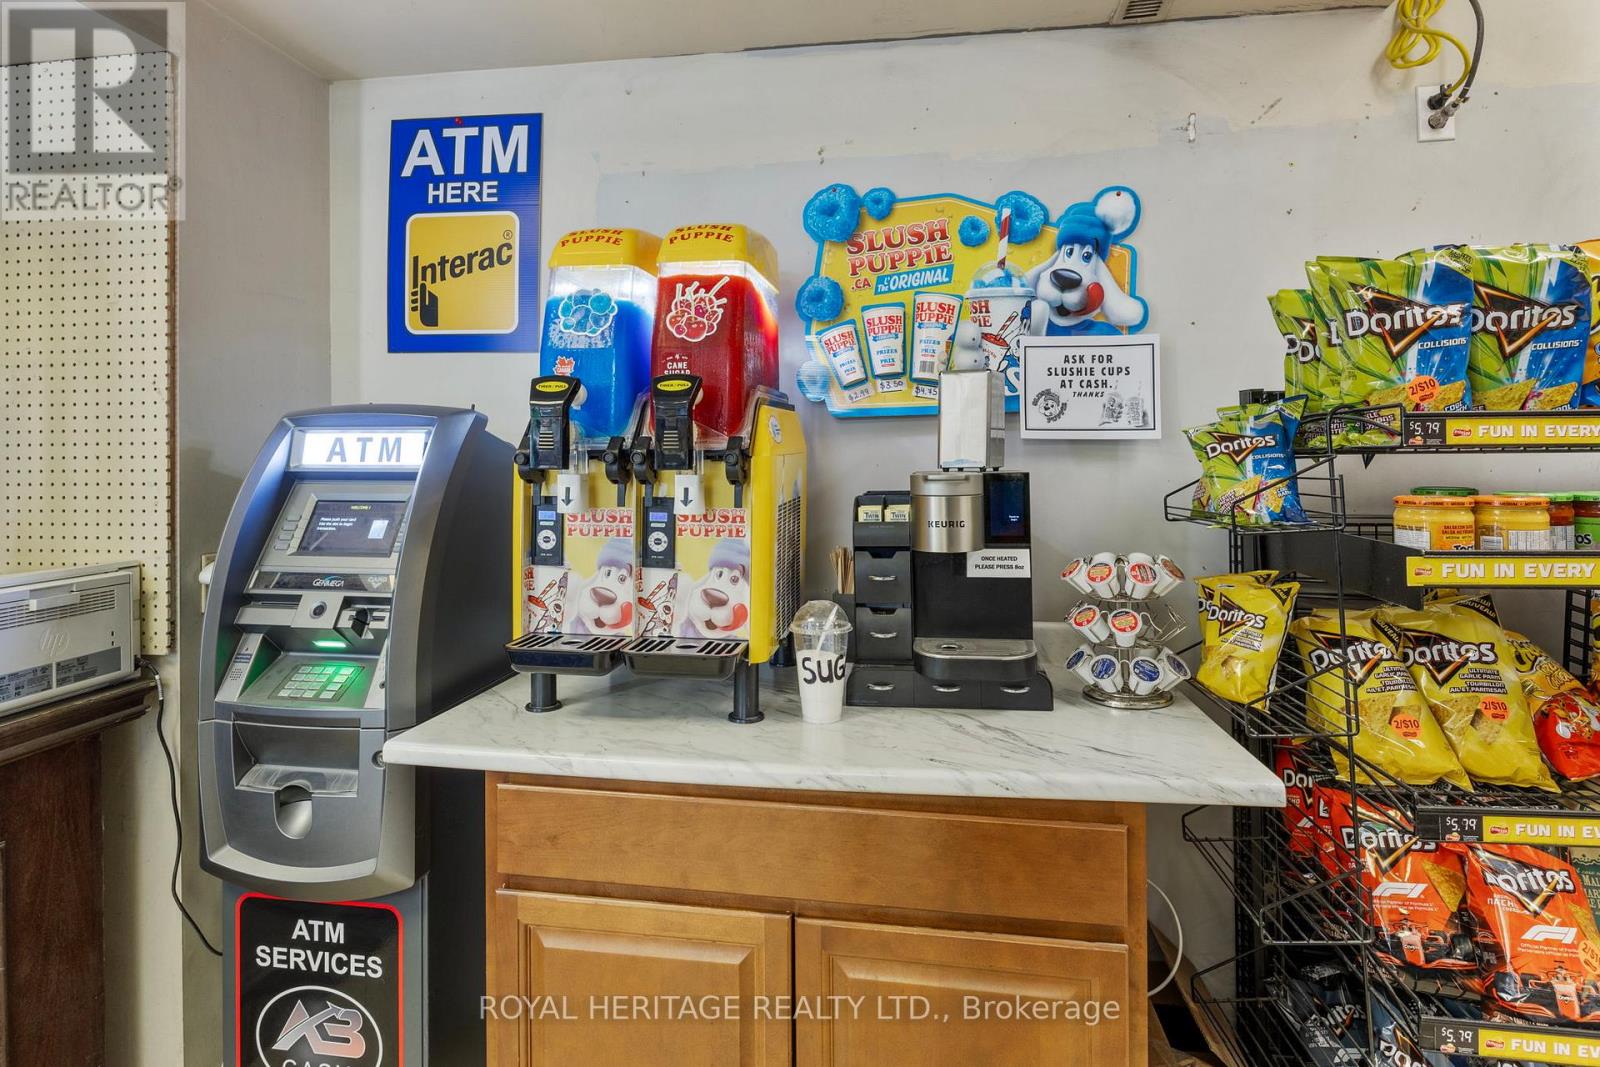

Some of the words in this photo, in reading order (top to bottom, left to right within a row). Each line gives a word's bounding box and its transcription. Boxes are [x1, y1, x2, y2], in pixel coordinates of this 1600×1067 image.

[401, 125, 529, 177] ATM
[428, 181, 498, 203] HERE
[567, 228, 624, 237] SLUSH
[674, 224, 736, 233] SLUSH
[560, 234, 624, 247] PUPPIE
[669, 232, 735, 245] PUPPIE
[846, 218, 950, 255] SLUSH
[412, 242, 513, 289] Interac
[915, 301, 956, 316] SLUSH
[866, 315, 903, 329] SLUSH
[1346, 303, 1464, 338] Doritos
[1472, 304, 1578, 332] Doritos
[823, 330, 855, 348] SLUSH
[1418, 337, 1467, 350] COLLISIONS
[1531, 339, 1580, 351] COLLISIONS
[666, 361, 688, 370] CANE
[1063, 354, 1086, 364] ASK
[1091, 354, 1114, 364] FOR
[1047, 366, 1096, 376] SLUSHIE
[1101, 366, 1131, 376] CUPS
[880, 380, 904, 390] $3.50
[1060, 379, 1074, 389] AT
[1079, 379, 1113, 389] CASH.
[848, 387, 870, 402] $2.99
[1409, 421, 1440, 435] $5.79
[1478, 424, 1514, 438] FUN
[1521, 424, 1538, 437] IN
[1544, 424, 1600, 438] EVERY
[326, 436, 402, 464] ATM
[1206, 434, 1276, 459] Doritos
[566, 508, 633, 524] SLUSH
[677, 508, 746, 524] SLUSH
[928, 520, 966, 528] KEURIG
[1441, 562, 1485, 578] FUN
[1494, 562, 1515, 578] IN
[1524, 562, 1596, 578] EVERY
[1208, 604, 1266, 629] Doritos
[1403, 641, 1496, 666] Doritos
[1446, 816, 1478, 831] $5.79
[1516, 823, 1551, 838] FUN
[1558, 825, 1575, 838] IN
[292, 918, 345, 944] ATM
[256, 945, 383, 978] SERVICES
[1441, 1027, 1473, 1043] $5.79
[1511, 1038, 1547, 1054] FUN
[1554, 1042, 1571, 1056] IN
